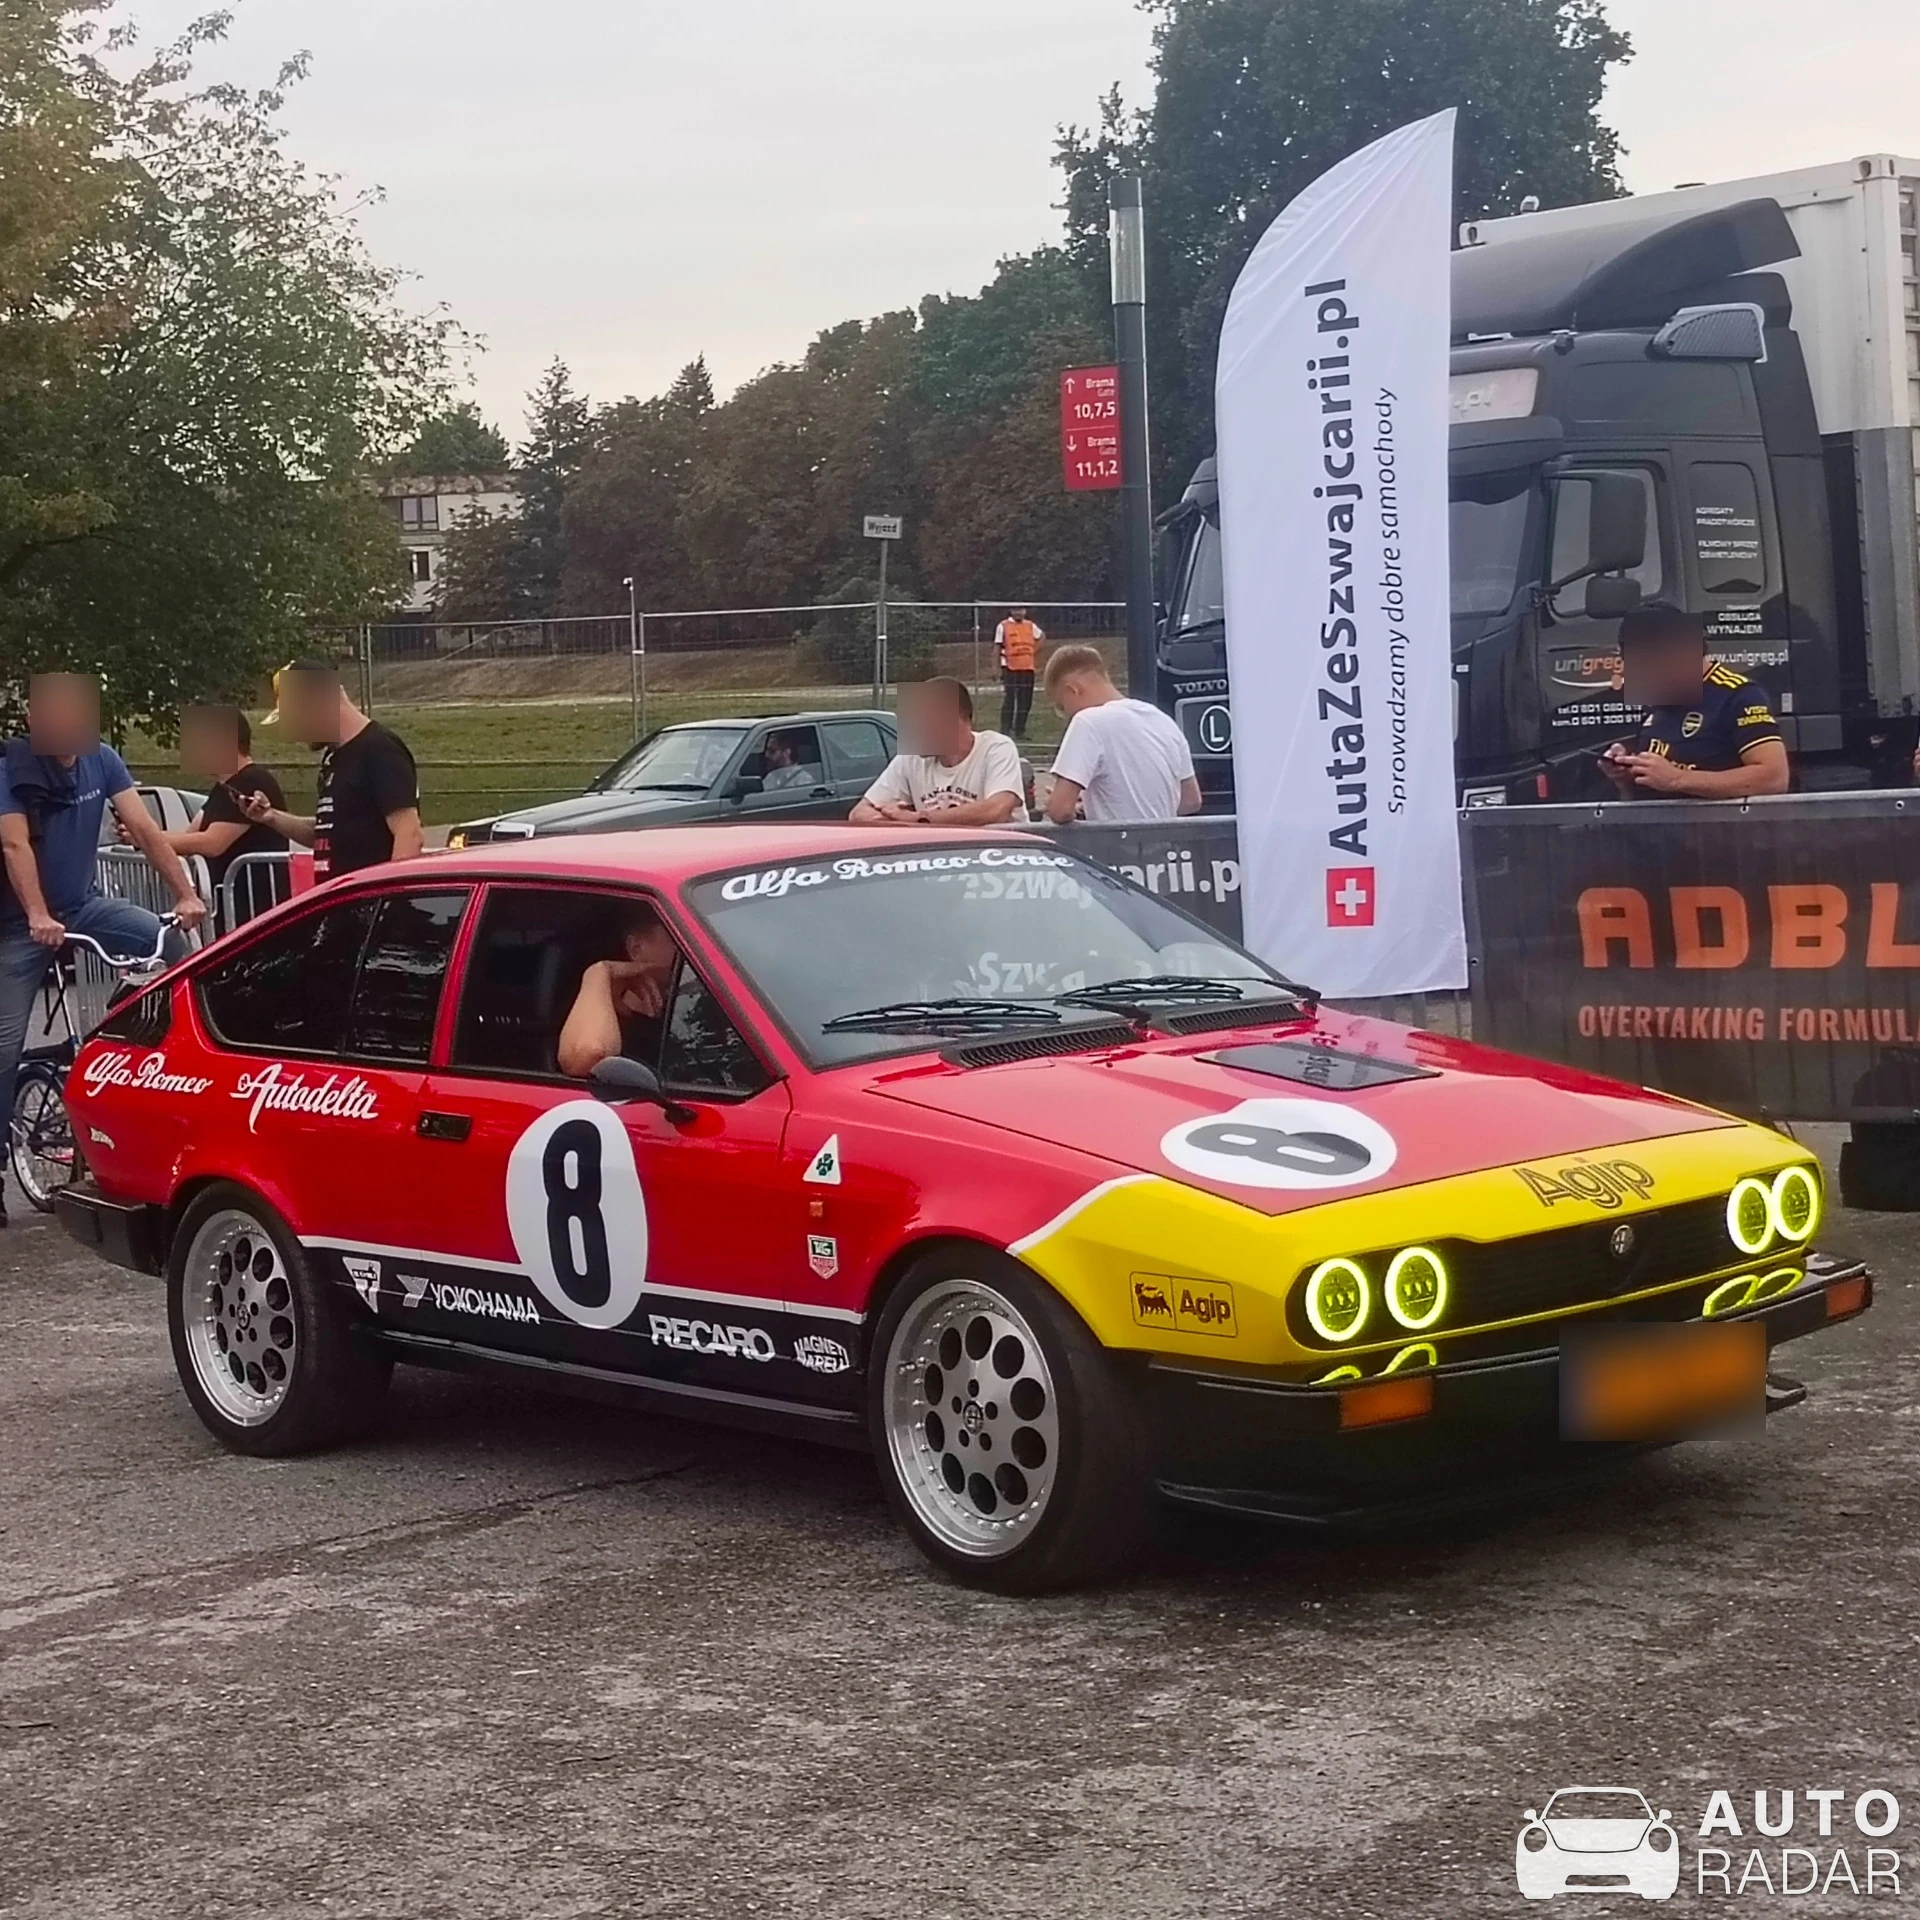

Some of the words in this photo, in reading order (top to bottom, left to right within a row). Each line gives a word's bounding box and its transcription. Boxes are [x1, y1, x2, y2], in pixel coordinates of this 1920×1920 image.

[1085, 378, 1115, 389] Brama
[1074, 401, 1116, 420] 10,7,5
[1087, 436, 1117, 447] Brama
[1076, 459, 1118, 477] 11,1,2
[1373, 387, 1400, 540] samochody
[1304, 279, 1368, 857] AutaZeSzwajcarii.pl
[1379, 547, 1405, 622] dobre
[1706, 624, 1763, 635] WYNAJEM
[1555, 654, 1625, 676] unigreg
[1174, 679, 1228, 694] VOLVO
[1209, 715, 1225, 743] L
[1386, 629, 1411, 816] Sprowadzamy
[721, 867, 831, 901] Alfa
[1578, 1005, 1765, 1042] OVERTAKING
[1779, 1006, 1920, 1043] FORMUL
[83, 1052, 133, 1097] Alfa
[131, 1052, 214, 1095] Romeo
[229, 1063, 379, 1135] Autodelta
[1184, 1122, 1372, 1177] 8
[1512, 1157, 1656, 1209] Agip
[542, 1118, 612, 1309] 8
[429, 1282, 541, 1325] YOKOHAMA
[1179, 1289, 1231, 1325] Agip
[648, 1313, 776, 1362] RECARO
